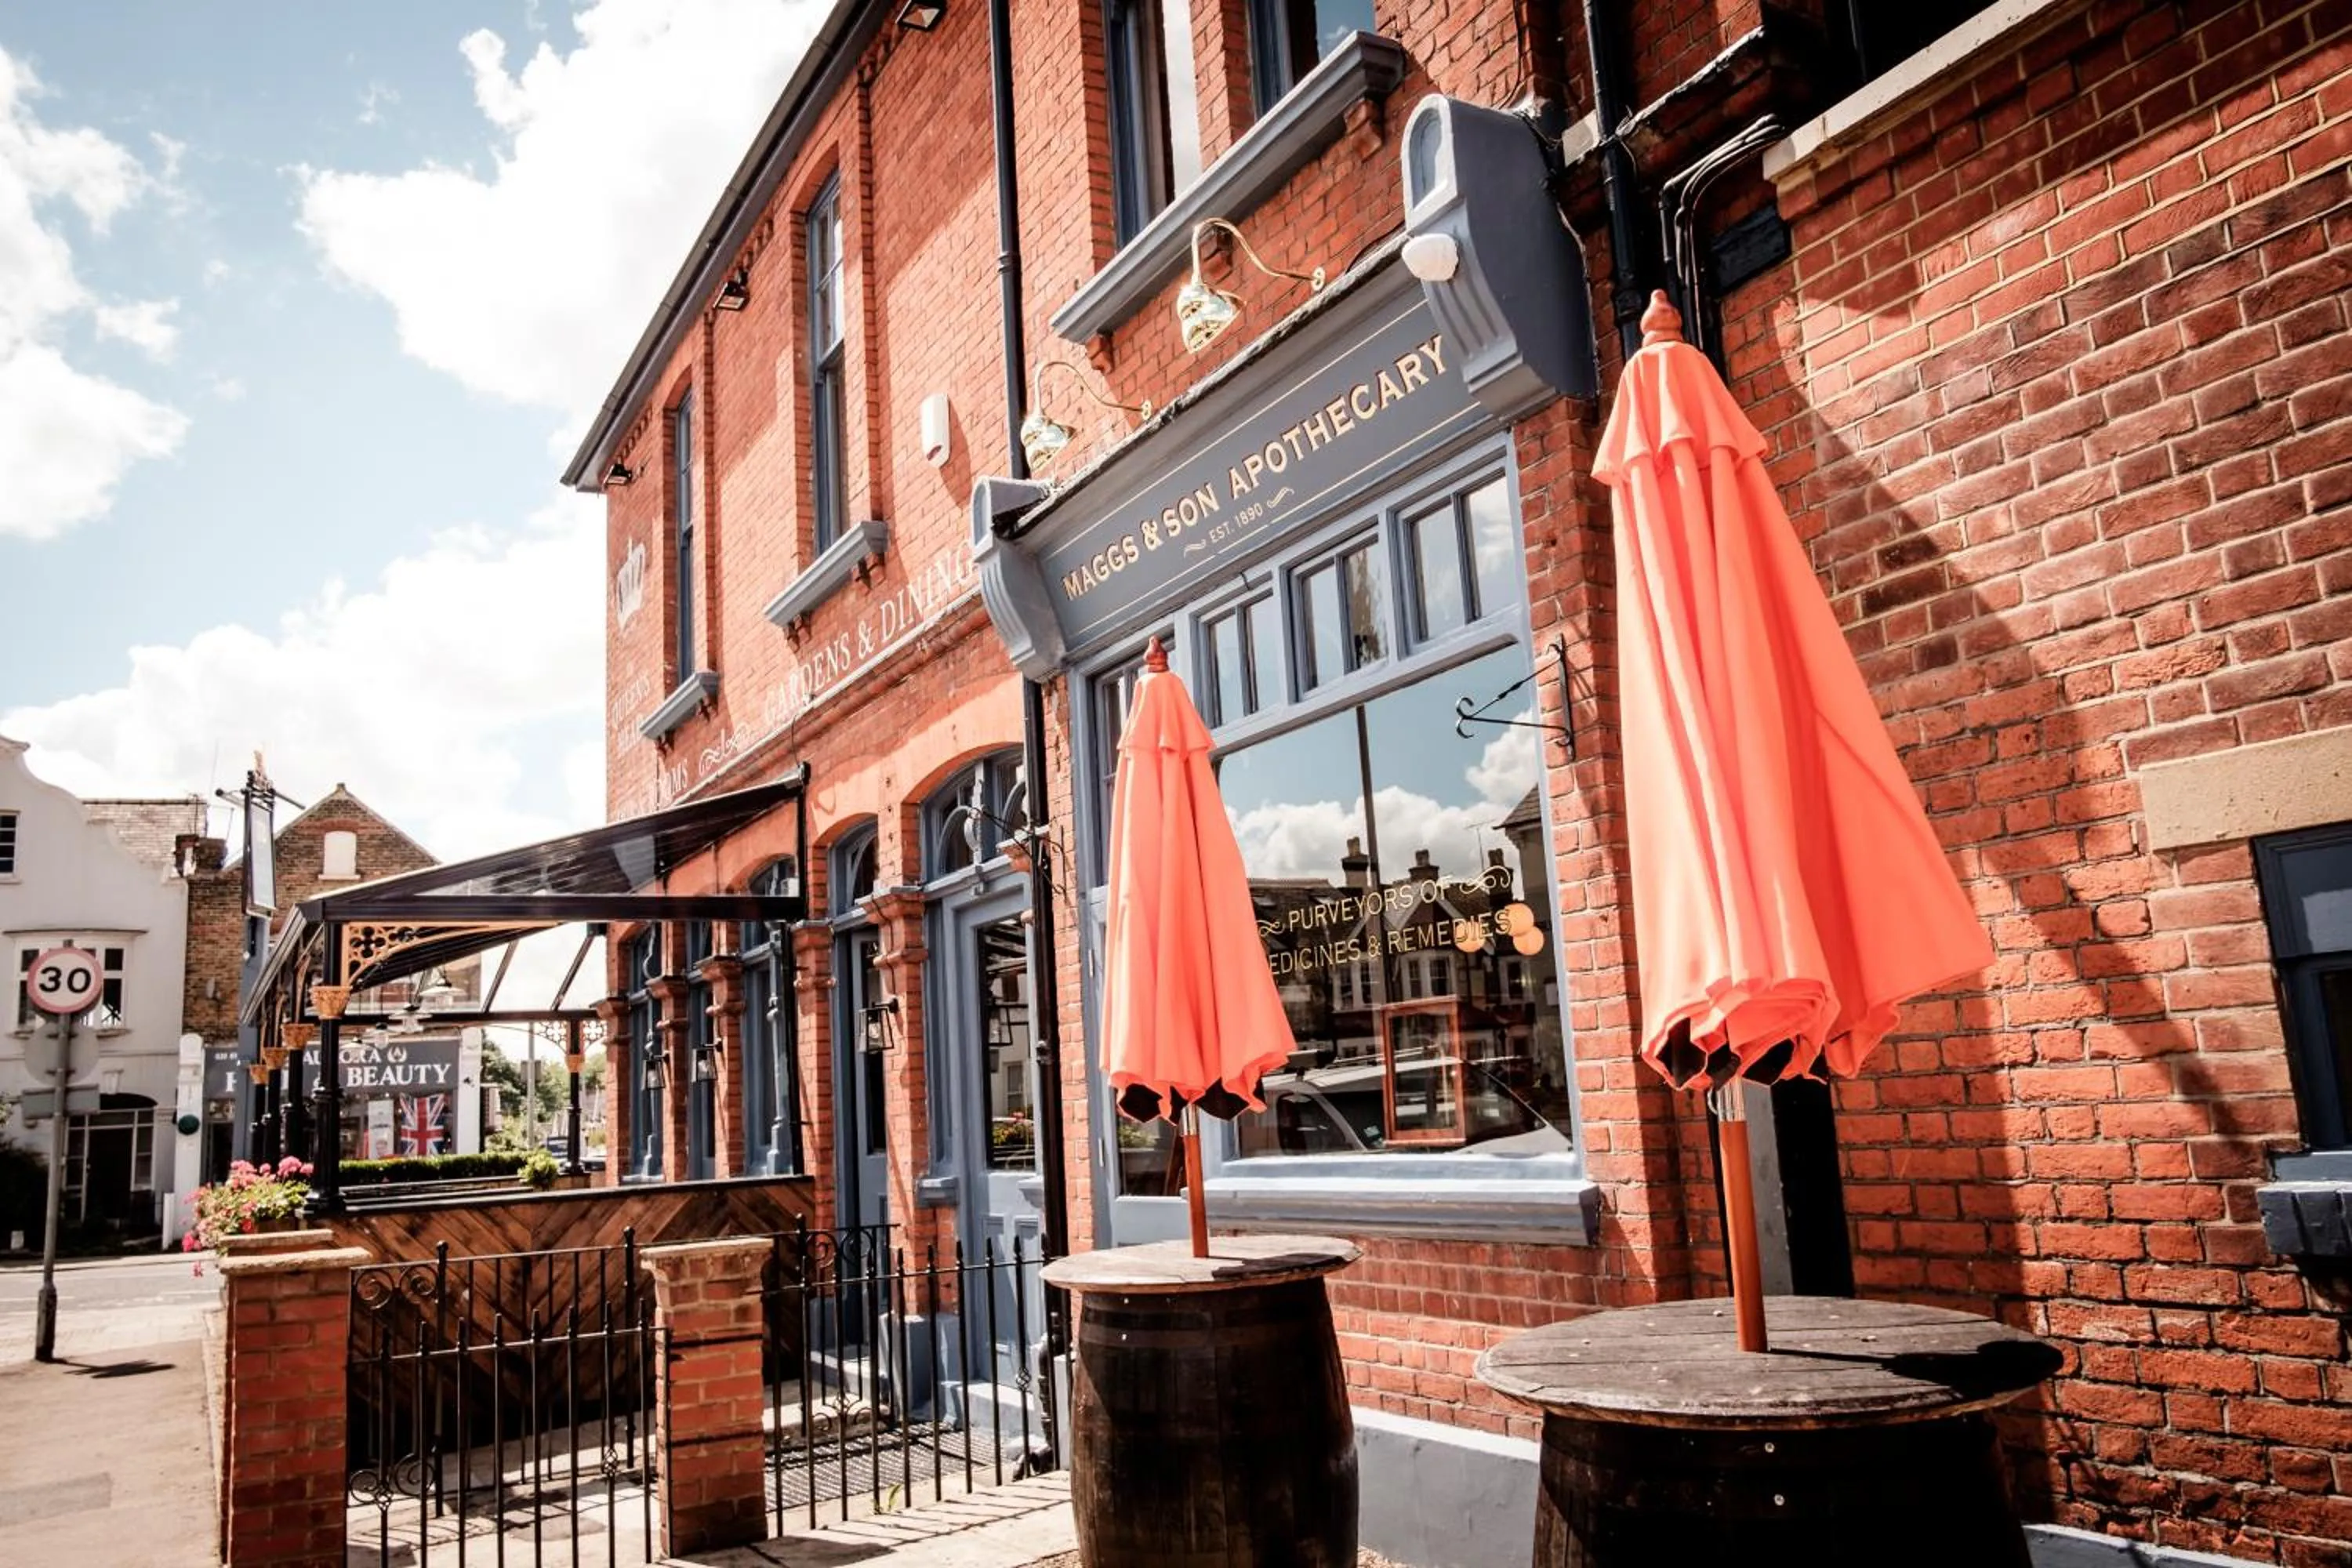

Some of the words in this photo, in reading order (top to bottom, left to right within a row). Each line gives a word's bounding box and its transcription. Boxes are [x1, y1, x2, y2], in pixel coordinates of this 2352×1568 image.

[1062, 534, 1139, 601] MAGGS
[1140, 518, 1163, 551] &
[1162, 481, 1221, 538] SON
[1229, 334, 1446, 500] APOTHECARY
[1209, 521, 1236, 543] EST.
[1235, 503, 1263, 528] 1890
[765, 632, 851, 724] GARDENS
[858, 619, 876, 660] &
[880, 539, 979, 643] DINING
[1288, 885, 1414, 932] PURVEYORS
[1420, 875, 1454, 904] OF
[1269, 938, 1362, 975] EDICINES
[1368, 935, 1381, 957] &
[1388, 909, 1512, 954] REMEDIES
[39, 966, 92, 993] 30
[347, 1064, 452, 1087] BEAUTY
